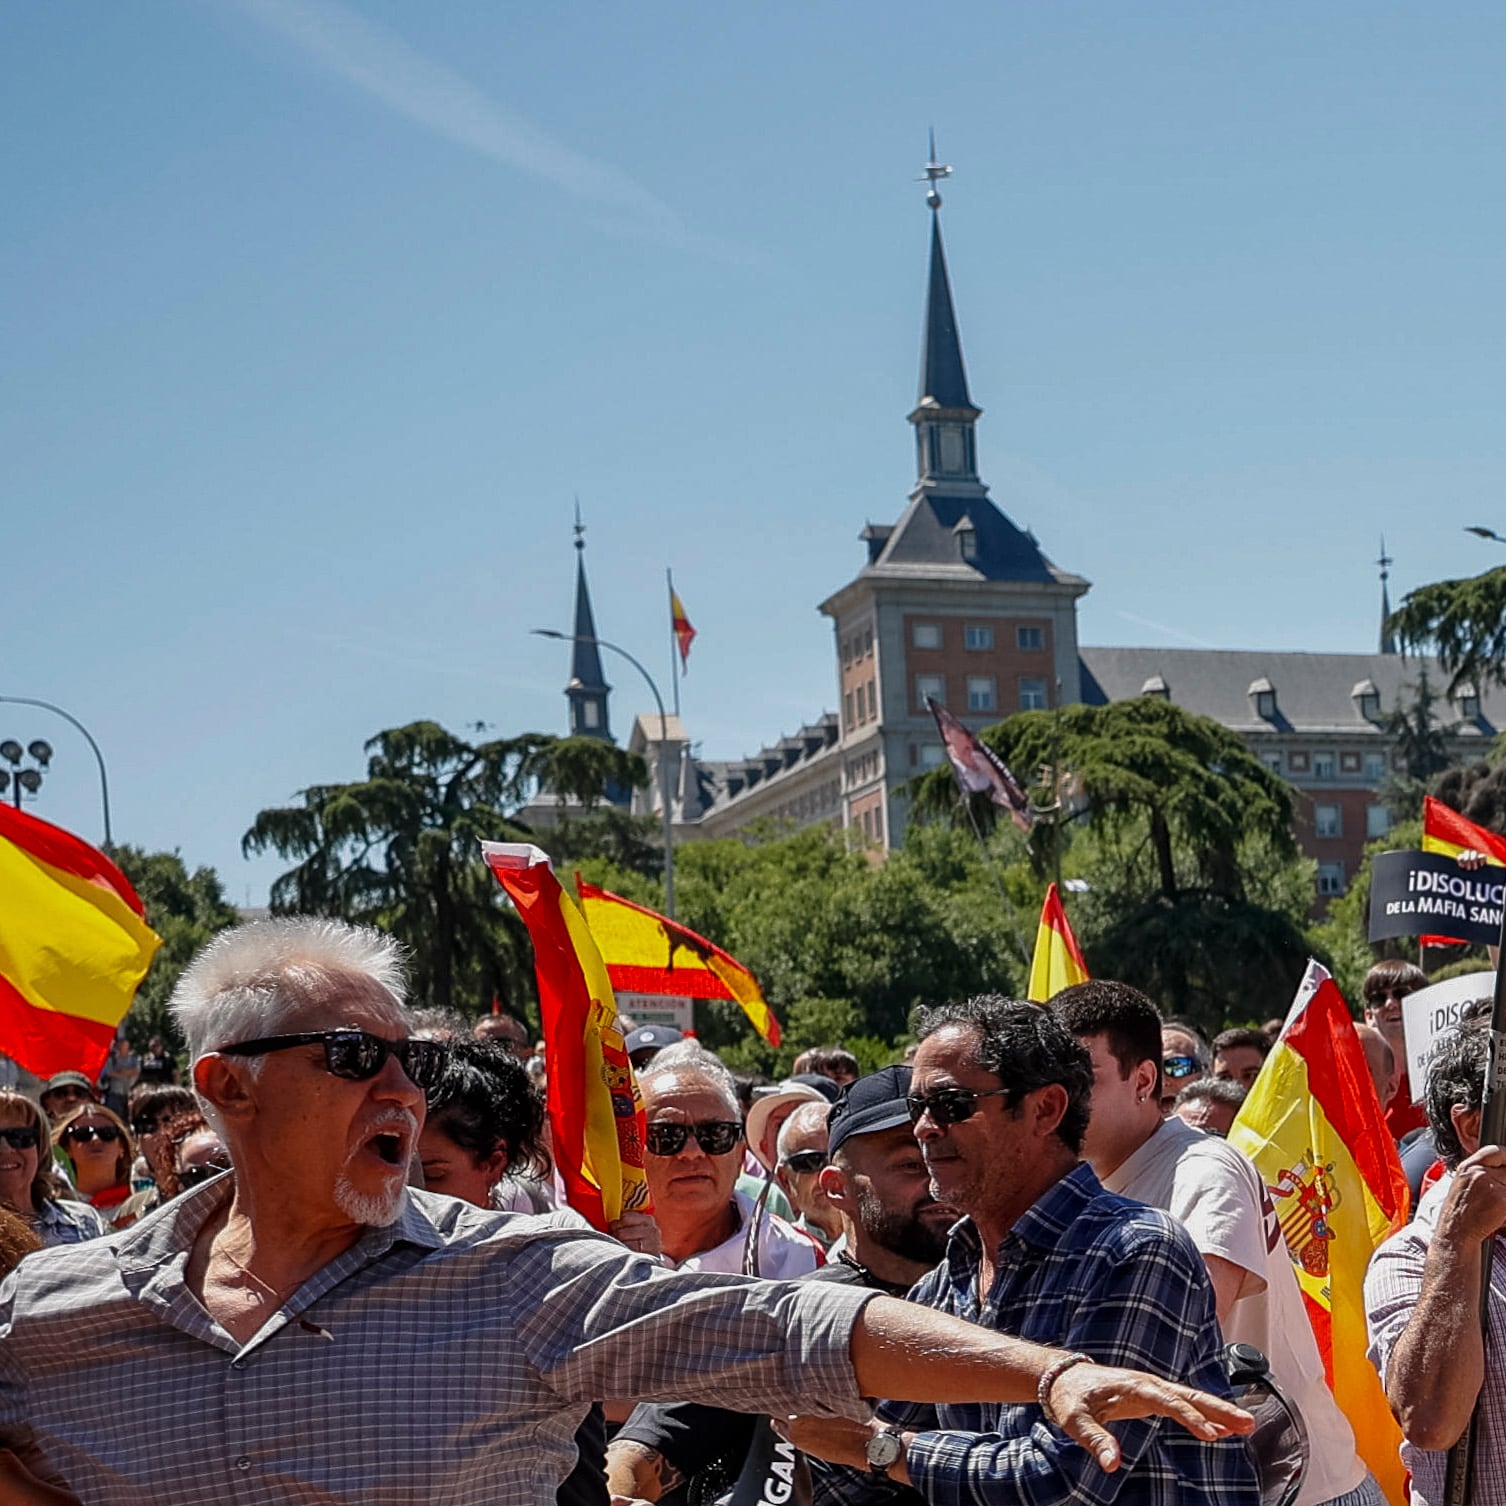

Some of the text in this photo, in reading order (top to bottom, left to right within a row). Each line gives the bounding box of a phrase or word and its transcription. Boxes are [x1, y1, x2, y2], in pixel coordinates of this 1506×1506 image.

[1386, 900, 1401, 915] DE
[1401, 901, 1415, 913] LA
[1417, 897, 1466, 919] MAFIA
